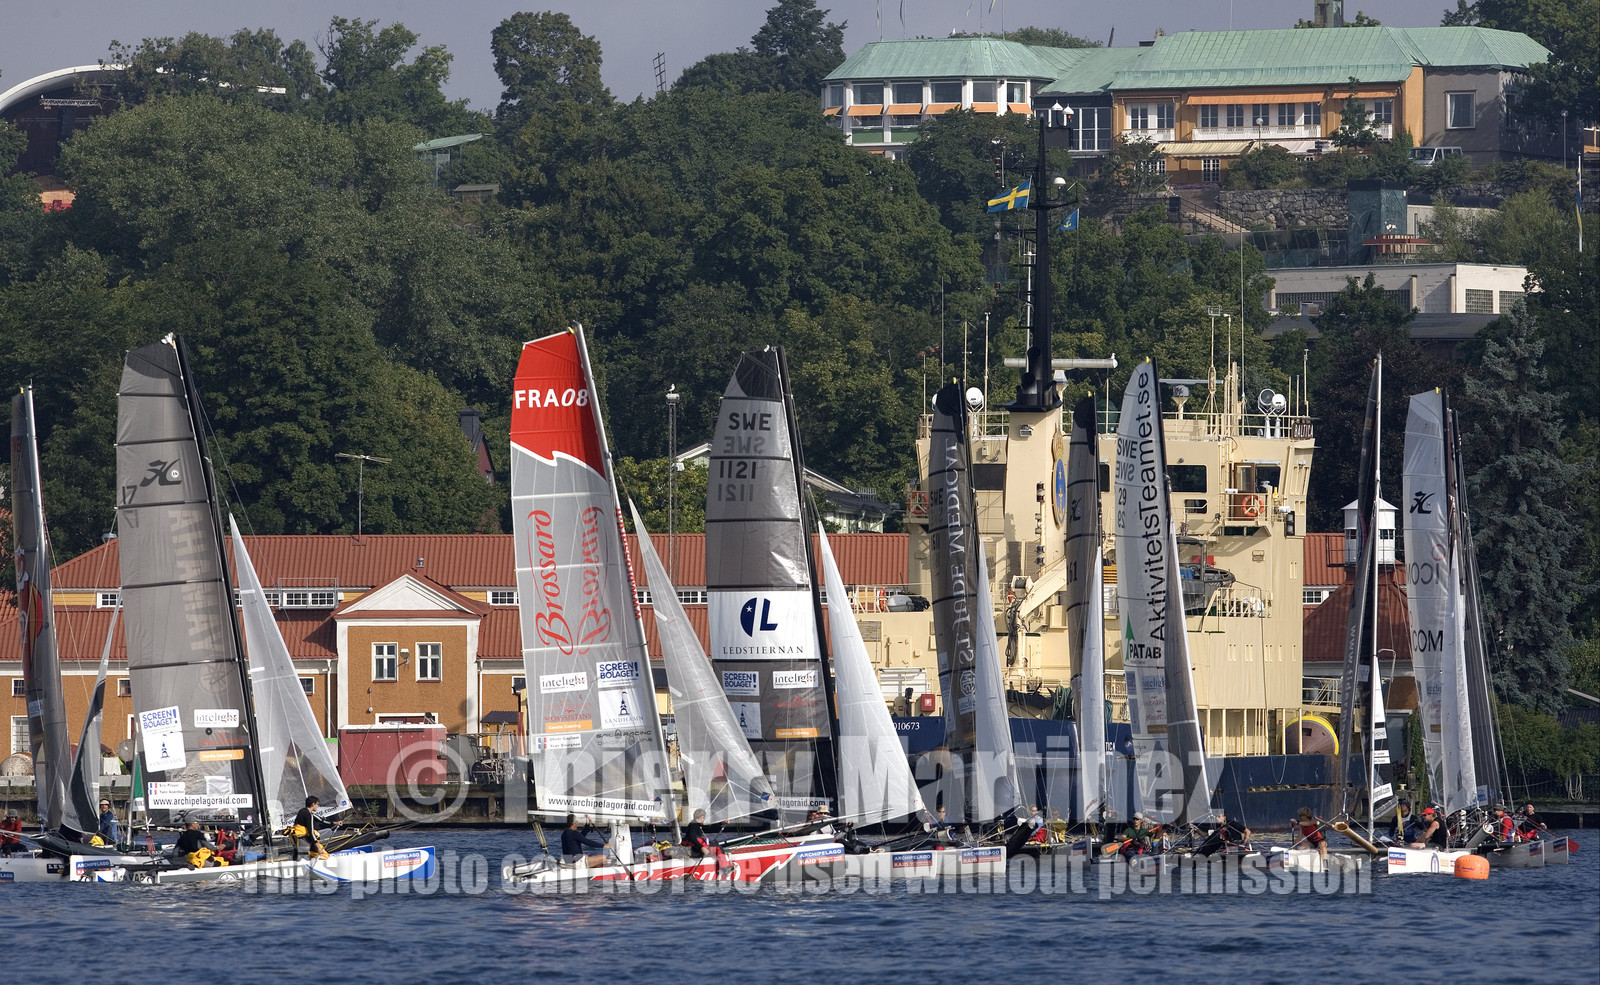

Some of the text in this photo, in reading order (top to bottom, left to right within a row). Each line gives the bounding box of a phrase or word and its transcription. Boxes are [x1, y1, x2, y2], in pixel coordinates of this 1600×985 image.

[514, 388, 589, 409] FRA08
[728, 412, 772, 431] SWE
[1116, 437, 1138, 459] SWE
[719, 460, 756, 479] 1121
[122, 485, 137, 505] 17
[1118, 487, 1127, 506] 29
[1136, 371, 1166, 641] AktivitetsTeamet.se
[527, 510, 573, 656] Brossard
[723, 645, 804, 655] LEDSTIERNAN
[600, 662, 634, 672] SCREEN
[541, 675, 586, 688] intelight
[723, 672, 752, 681] SCREEN
[774, 674, 816, 685] intelight
[724, 680, 752, 688] BOLAGET
[141, 709, 173, 722] SCREEN
[196, 711, 238, 723] intelight
[604, 715, 645, 725] SANDHAMN
[143, 717, 173, 730] BOLAGET
[893, 721, 920, 731] 010673
[153, 795, 248, 807] www.archipelagoraid.com
[548, 797, 656, 812] www.archipelagoraid.com
[384, 852, 420, 860] ARCHIPELAGO
[800, 849, 842, 858] ARCHIPELAGO
[963, 849, 1000, 857] ARCHIPELAGO
[77, 860, 110, 868] ARCHIPELAGO
